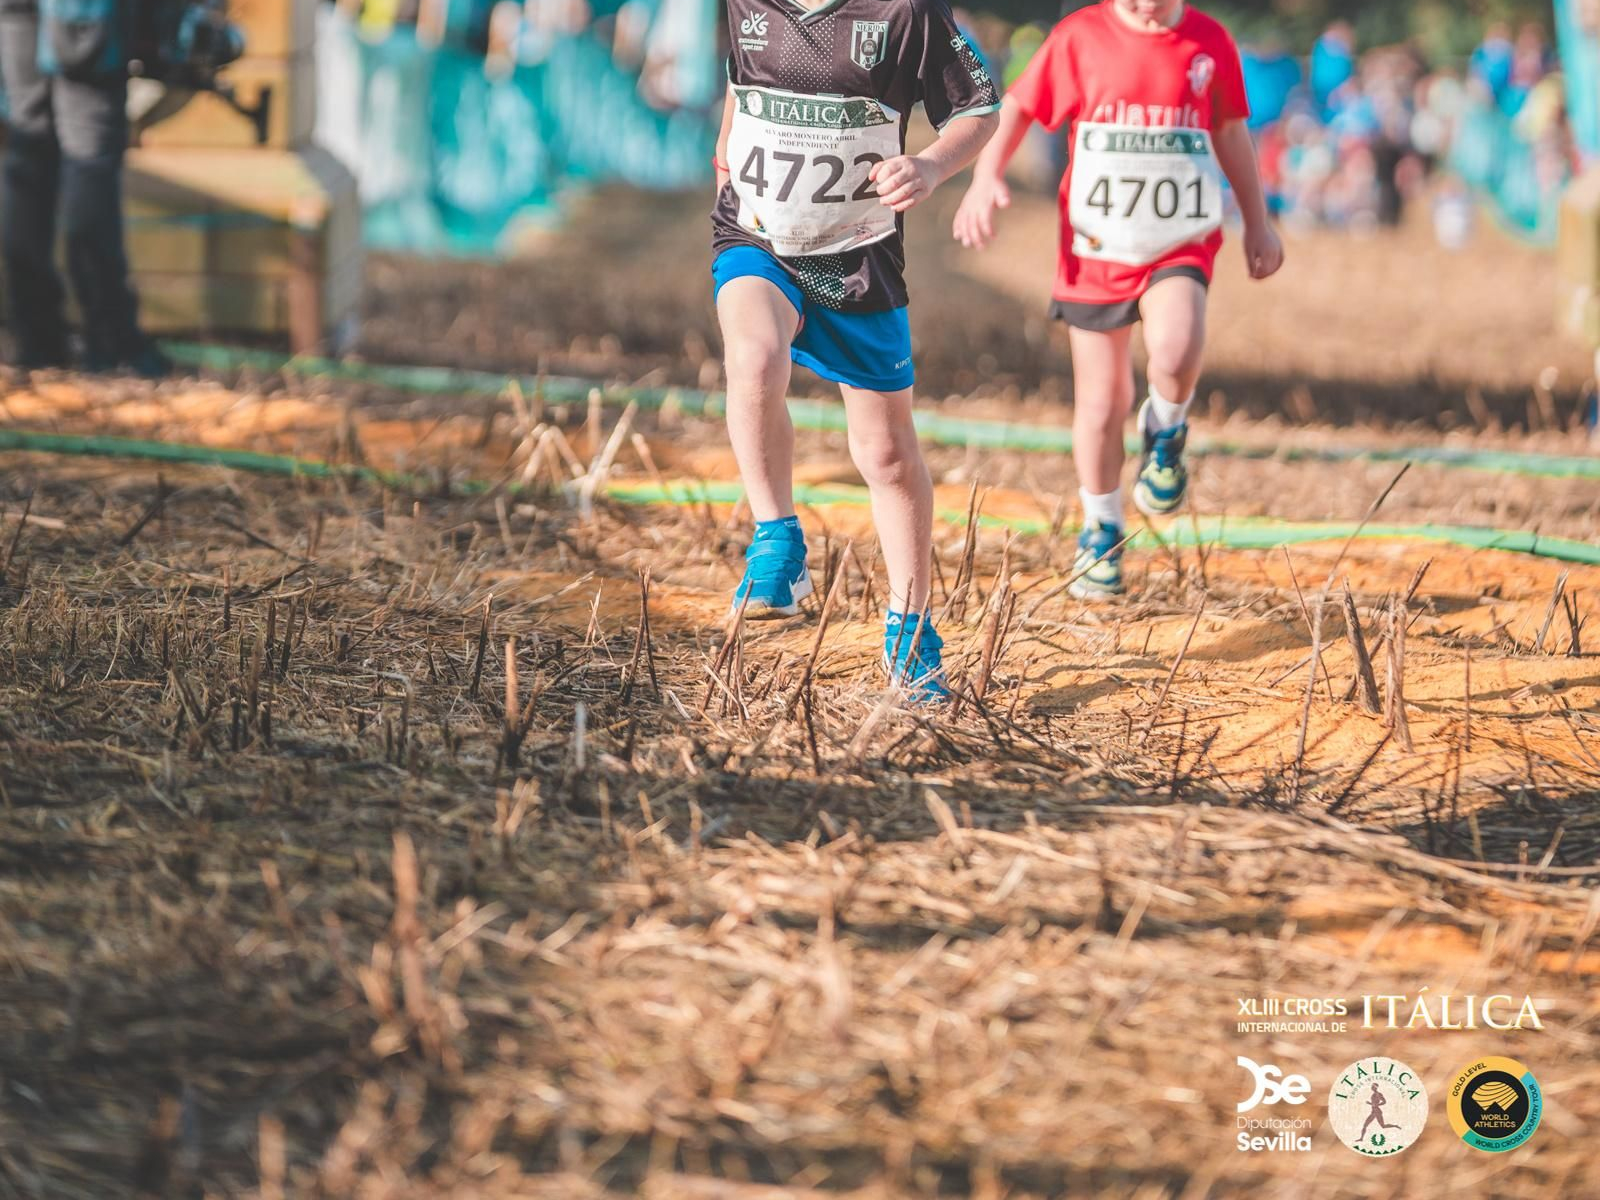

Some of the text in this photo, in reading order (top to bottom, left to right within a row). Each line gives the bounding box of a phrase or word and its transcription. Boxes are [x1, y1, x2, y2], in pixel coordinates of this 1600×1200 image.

[769, 100, 851, 124] ITÁLICA
[740, 146, 884, 203] 4722
[1087, 176, 1208, 219] 4701
